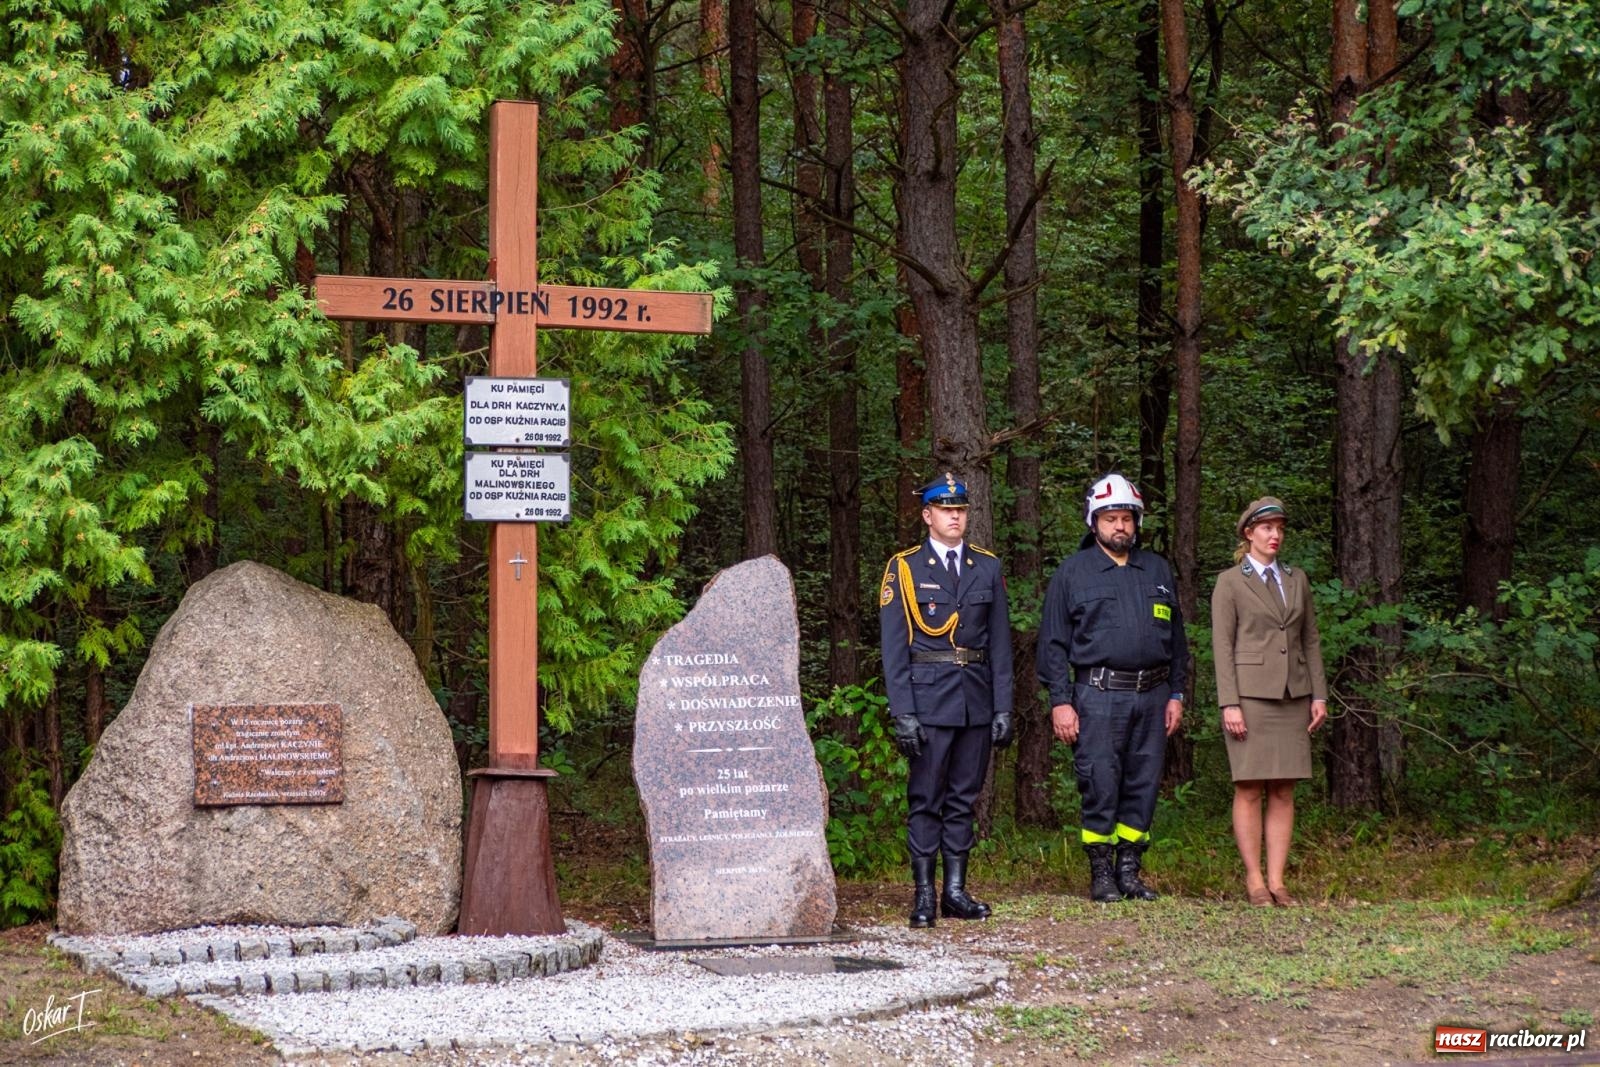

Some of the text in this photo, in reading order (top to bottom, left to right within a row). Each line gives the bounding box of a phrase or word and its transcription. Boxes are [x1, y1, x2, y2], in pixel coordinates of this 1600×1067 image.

[382, 287, 652, 323] 26 SIERPIEŃ 1992 r.
[491, 384, 504, 393] KU
[470, 401, 489, 409] DLA
[492, 401, 512, 410] DRH
[469, 416, 482, 424] OD
[484, 416, 503, 425] OSP
[541, 418, 566, 426] RACIB
[491, 459, 504, 468] KU
[499, 469, 540, 478] DLA DRH
[475, 480, 555, 489] MALINOWSKIEGO
[469, 491, 482, 500] OD
[484, 492, 503, 500] OSP
[541, 492, 566, 501] RACIB
[664, 653, 739, 666] TRAGEDIA
[671, 673, 769, 688] WSPÓŁPRACA
[681, 695, 800, 711] DOŚWIADCZENIE
[689, 715, 781, 732] PRZYSZŁOŚĆ
[280, 740, 323, 749] KACZYNIE
[260, 752, 331, 761] MALINOWSKIEMU
[718, 768, 749, 780] 25 lat
[680, 782, 789, 798] po wielkim pożarze
[704, 808, 768, 821] Pamiętamy
